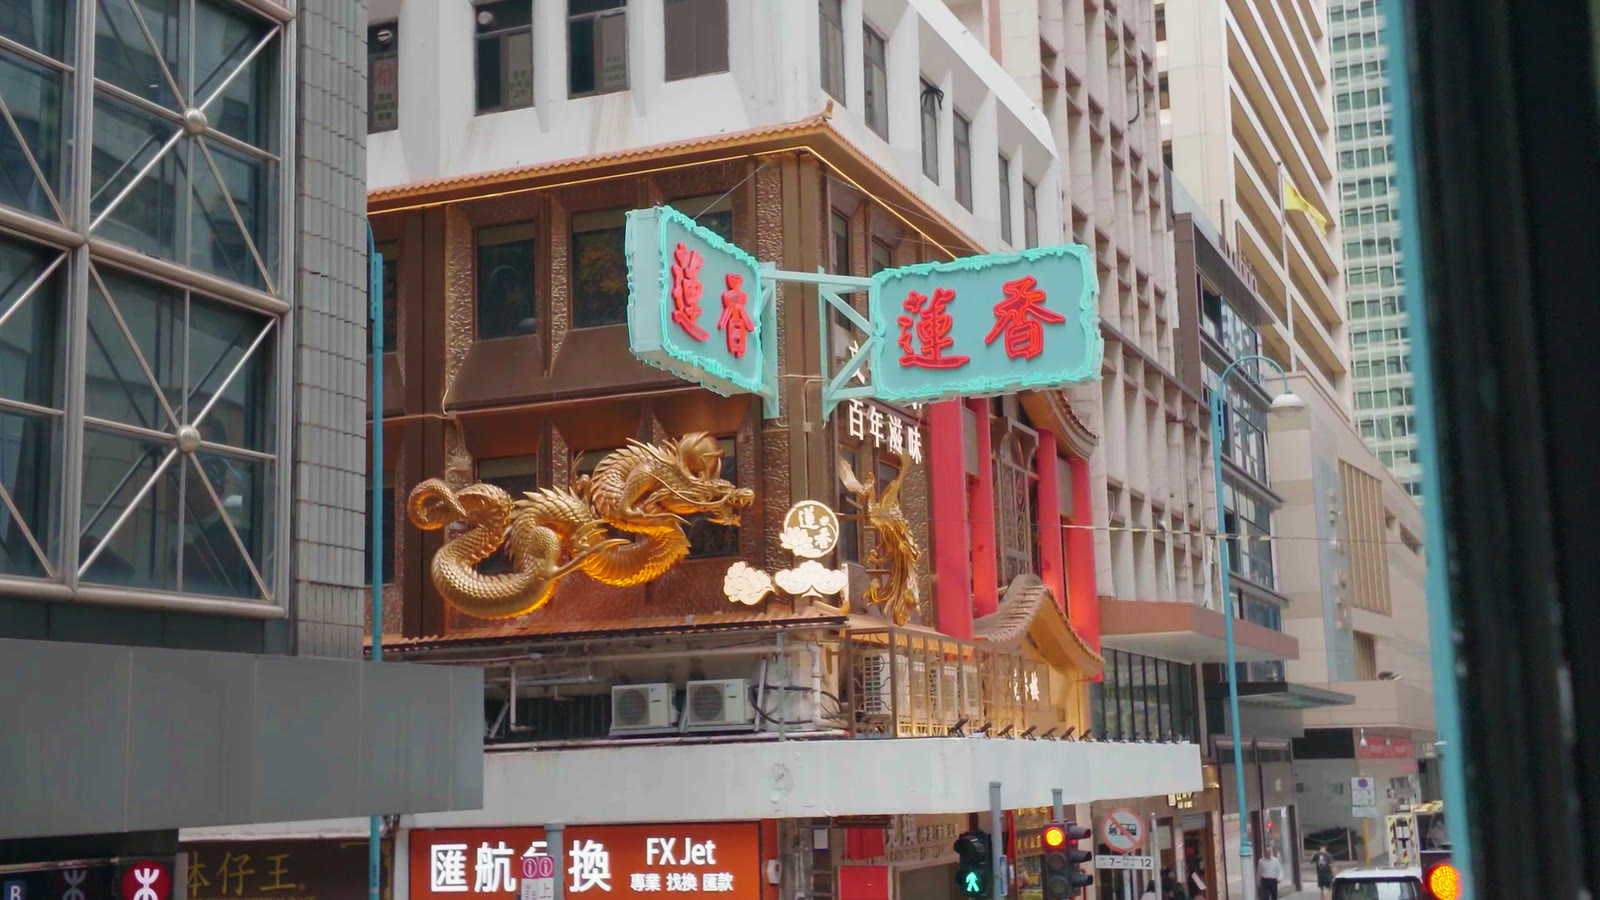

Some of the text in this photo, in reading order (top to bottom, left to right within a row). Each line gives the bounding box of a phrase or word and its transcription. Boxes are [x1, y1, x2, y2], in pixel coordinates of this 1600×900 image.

[670, 241, 754, 358] 蓮香
[896, 275, 1067, 369] 蓮香
[849, 398, 922, 465] 百年滋味
[430, 839, 612, 893] 匯航換
[646, 838, 717, 866] FX Jet
[1140, 858, 1152, 868] 12
[10, 885, 21, 900] B
[630, 873, 734, 892] 專業 找換 匯款
